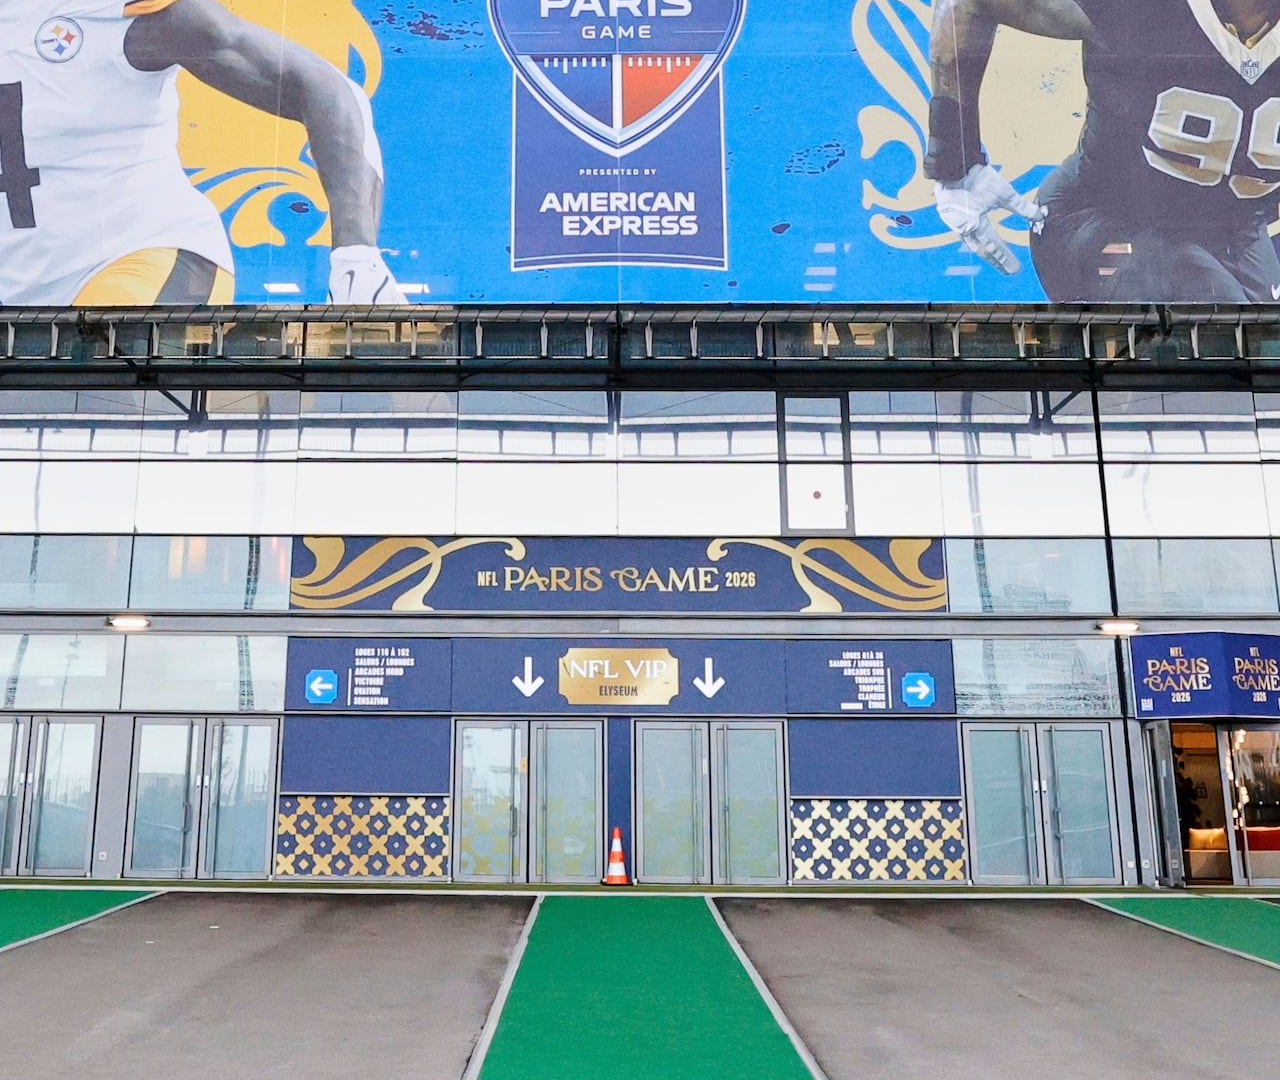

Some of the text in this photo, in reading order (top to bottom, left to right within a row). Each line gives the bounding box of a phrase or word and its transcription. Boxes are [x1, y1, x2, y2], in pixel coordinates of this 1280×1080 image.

[581, 25, 652, 39] GAME
[579, 168, 639, 176] PRESENTED
[539, 192, 695, 212] AMERICAN
[562, 215, 699, 236] EXPRESS
[477, 566, 756, 592] NFL PARIS GAME 2026
[1169, 647, 1184, 657] NFL
[570, 659, 668, 678] NFL VIP
[1147, 657, 1209, 675] PARIS
[1234, 657, 1279, 675] PARIS
[599, 685, 638, 696] ELYSEUM
[1143, 674, 1212, 692] GAME
[1232, 674, 1280, 692] GAME
[1171, 692, 1191, 702] 2026
